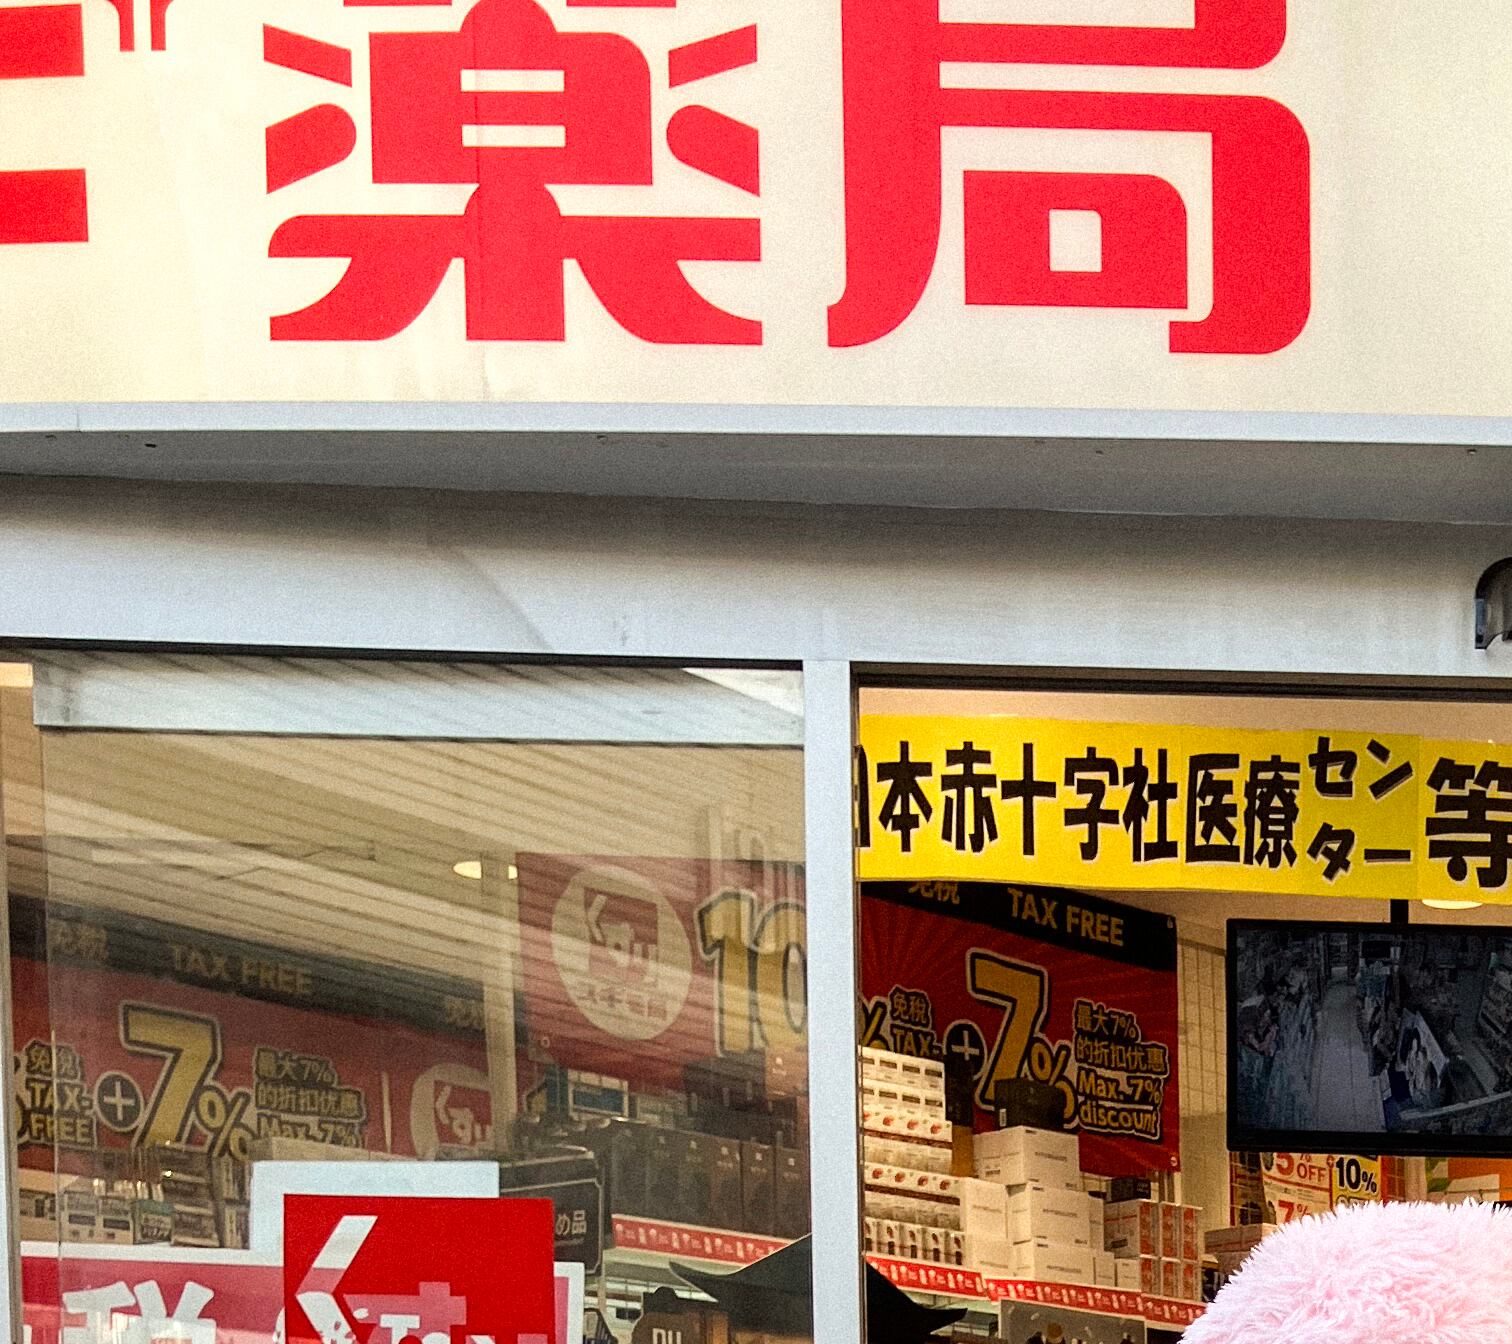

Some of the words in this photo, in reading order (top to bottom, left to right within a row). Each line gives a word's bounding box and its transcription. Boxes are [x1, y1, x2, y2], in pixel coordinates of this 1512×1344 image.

[1007, 888, 1059, 929] TAX
[1066, 905, 1124, 947] FREE
[1077, 1068, 1124, 1099] Max.
[1080, 1102, 1157, 1134] discount
[1335, 1156, 1377, 1194] 10%
